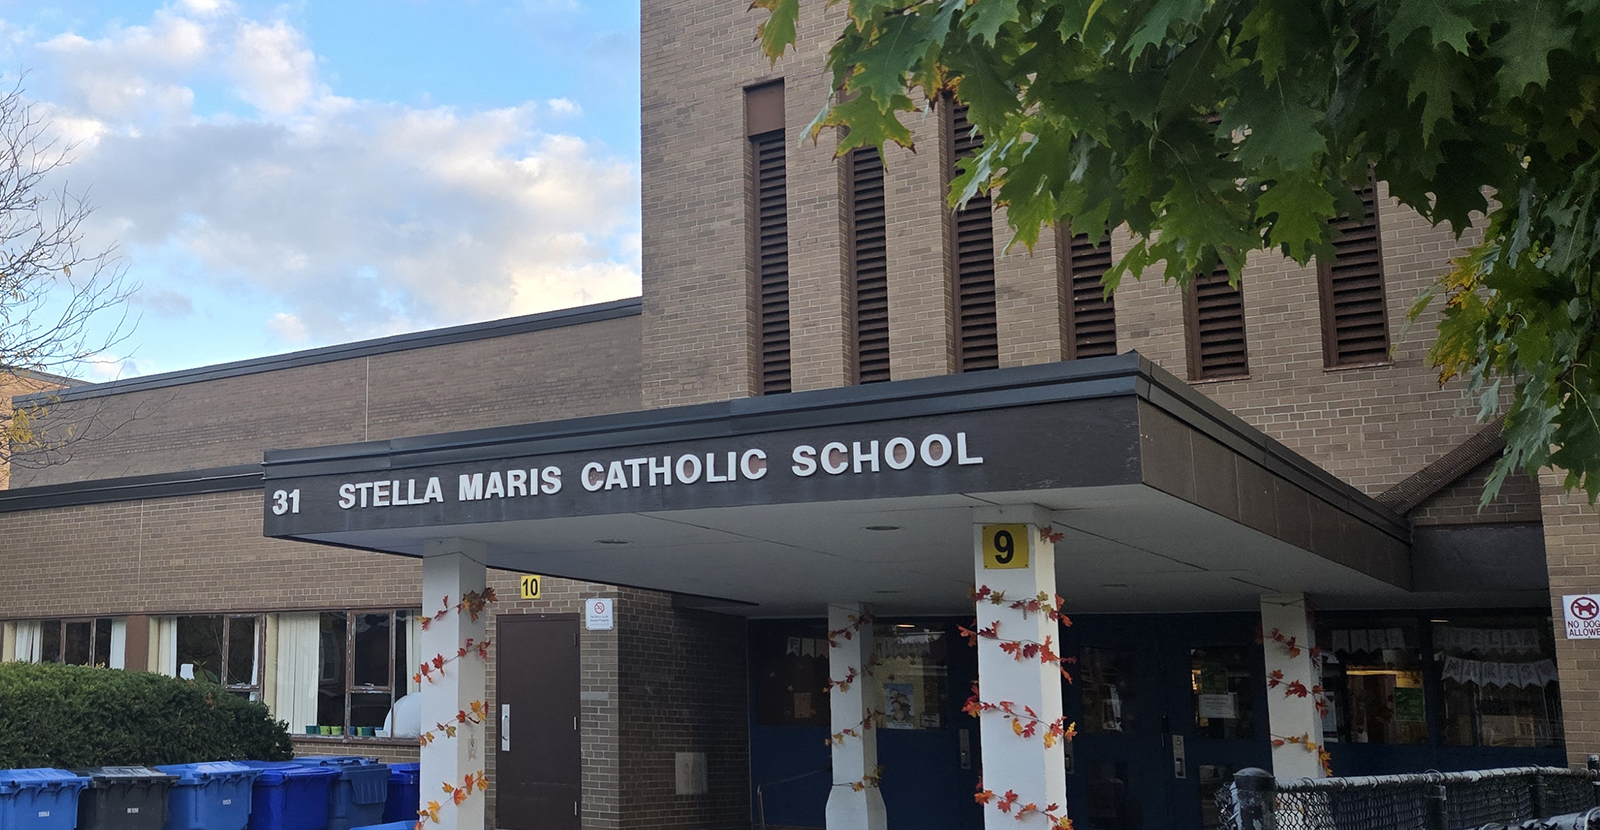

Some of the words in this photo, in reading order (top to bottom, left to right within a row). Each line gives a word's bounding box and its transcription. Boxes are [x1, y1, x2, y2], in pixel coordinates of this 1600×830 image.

[338, 476, 444, 509] STELLA
[458, 465, 563, 502] MARIS
[580, 448, 768, 492] CATHOLIC
[791, 432, 984, 478] SCHOOL
[272, 488, 300, 516] 31
[993, 529, 1015, 565] 9
[522, 578, 538, 597] 10
[1567, 620, 1580, 629] NO
[1443, 658, 1534, 680] MARIS
